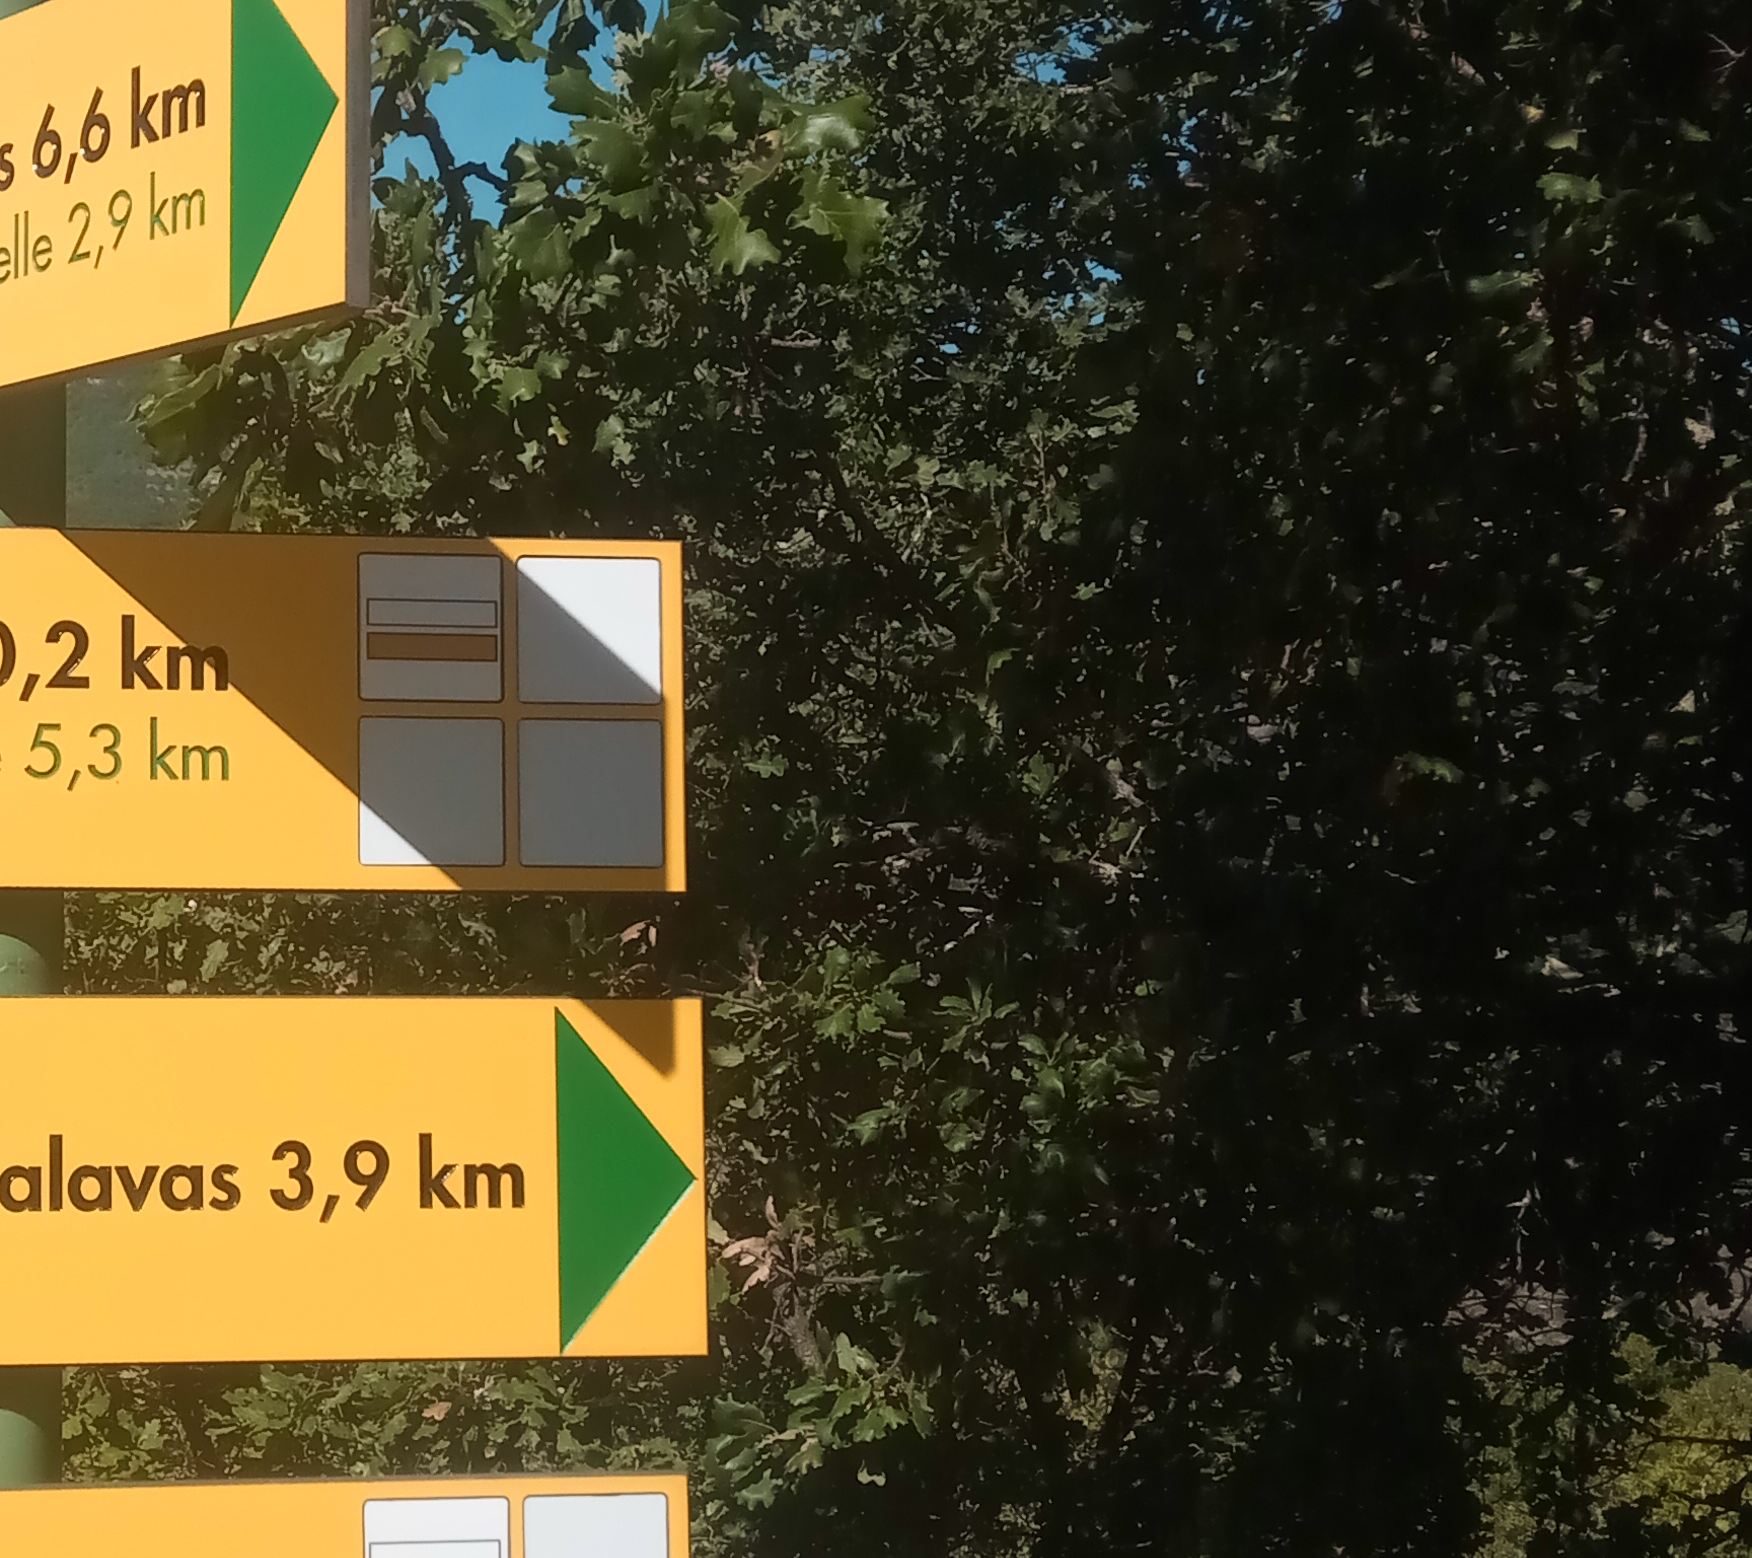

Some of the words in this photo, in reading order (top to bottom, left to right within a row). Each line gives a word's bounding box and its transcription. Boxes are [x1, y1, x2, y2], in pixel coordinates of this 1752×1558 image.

[32, 86, 111, 185] 6,6
[130, 65, 206, 149] km
[68, 189, 133, 269] 2,9
[150, 171, 206, 240] km
[121, 615, 229, 692] km
[25, 723, 122, 792] 5,3
[150, 717, 230, 781] km
[270, 1140, 390, 1223] 3,9
[418, 1133, 526, 1210] km
